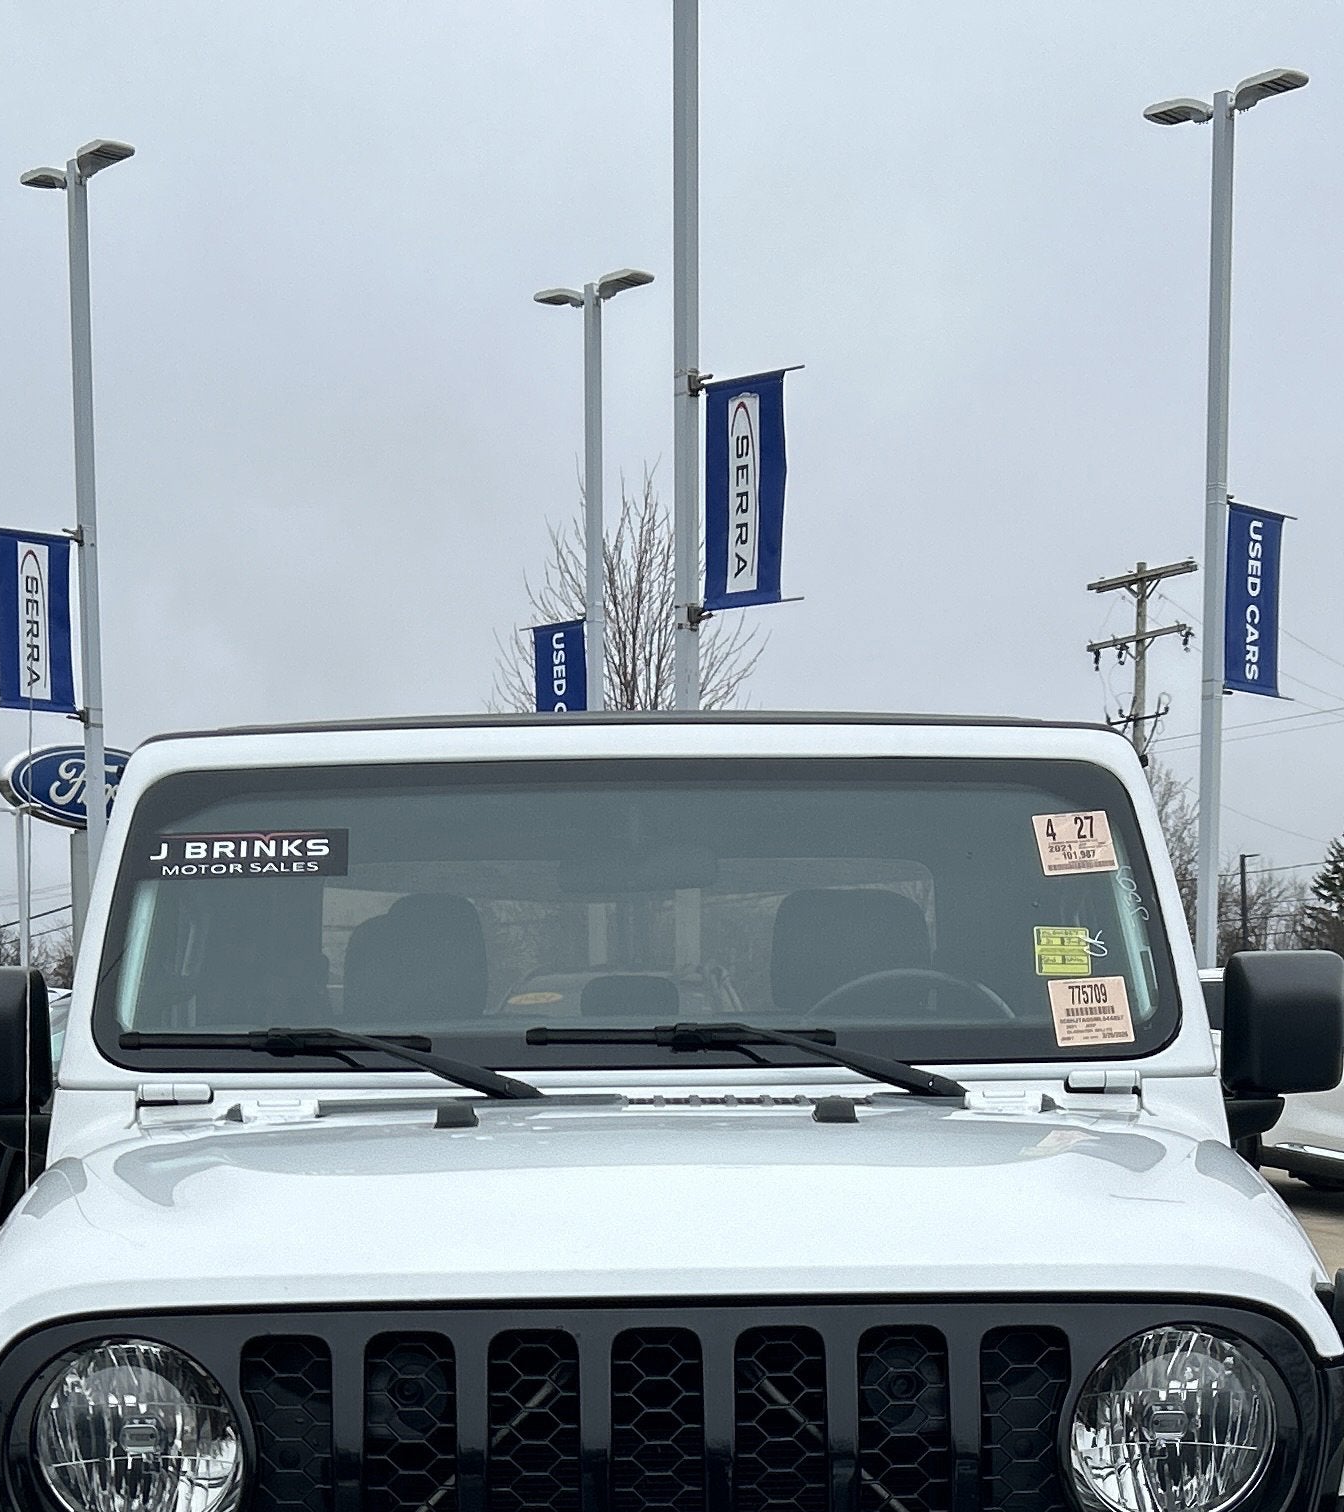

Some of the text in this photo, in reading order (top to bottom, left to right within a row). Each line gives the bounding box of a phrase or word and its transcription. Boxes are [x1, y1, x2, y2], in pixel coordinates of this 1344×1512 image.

[734, 434, 749, 578] SERRA
[1245, 519, 1263, 681] USED CARS
[25, 575, 41, 687] SERRA
[552, 632, 567, 696] USED
[1046, 815, 1094, 840] 4 27
[150, 838, 330, 860] J BRINKS
[1048, 844, 1072, 853] 2021
[162, 861, 319, 876] MOTOR SALES
[1068, 983, 1108, 1005] 775709
